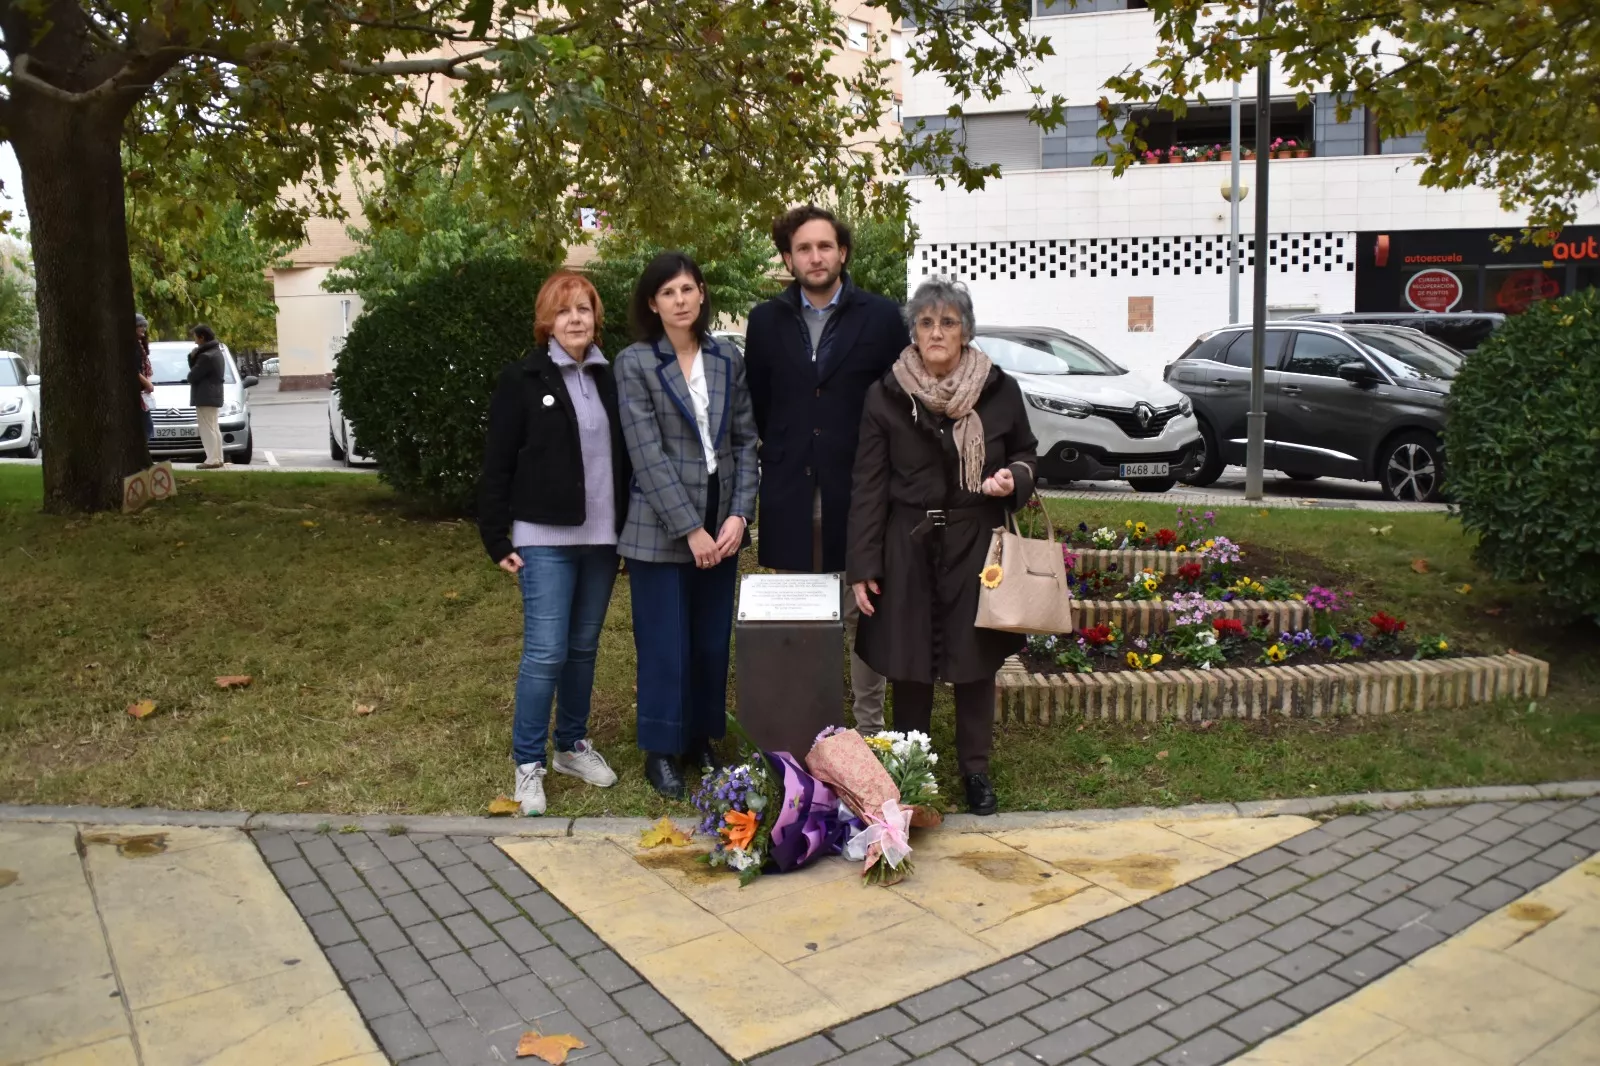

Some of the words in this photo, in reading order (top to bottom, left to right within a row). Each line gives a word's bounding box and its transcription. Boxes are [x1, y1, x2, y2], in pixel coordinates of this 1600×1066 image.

[1404, 252, 1462, 263] autoescuela
[156, 428, 177, 437] 9276
[180, 428, 196, 437] DHG
[1126, 464, 1149, 476] 8468
[1151, 464, 1167, 475] JLC
